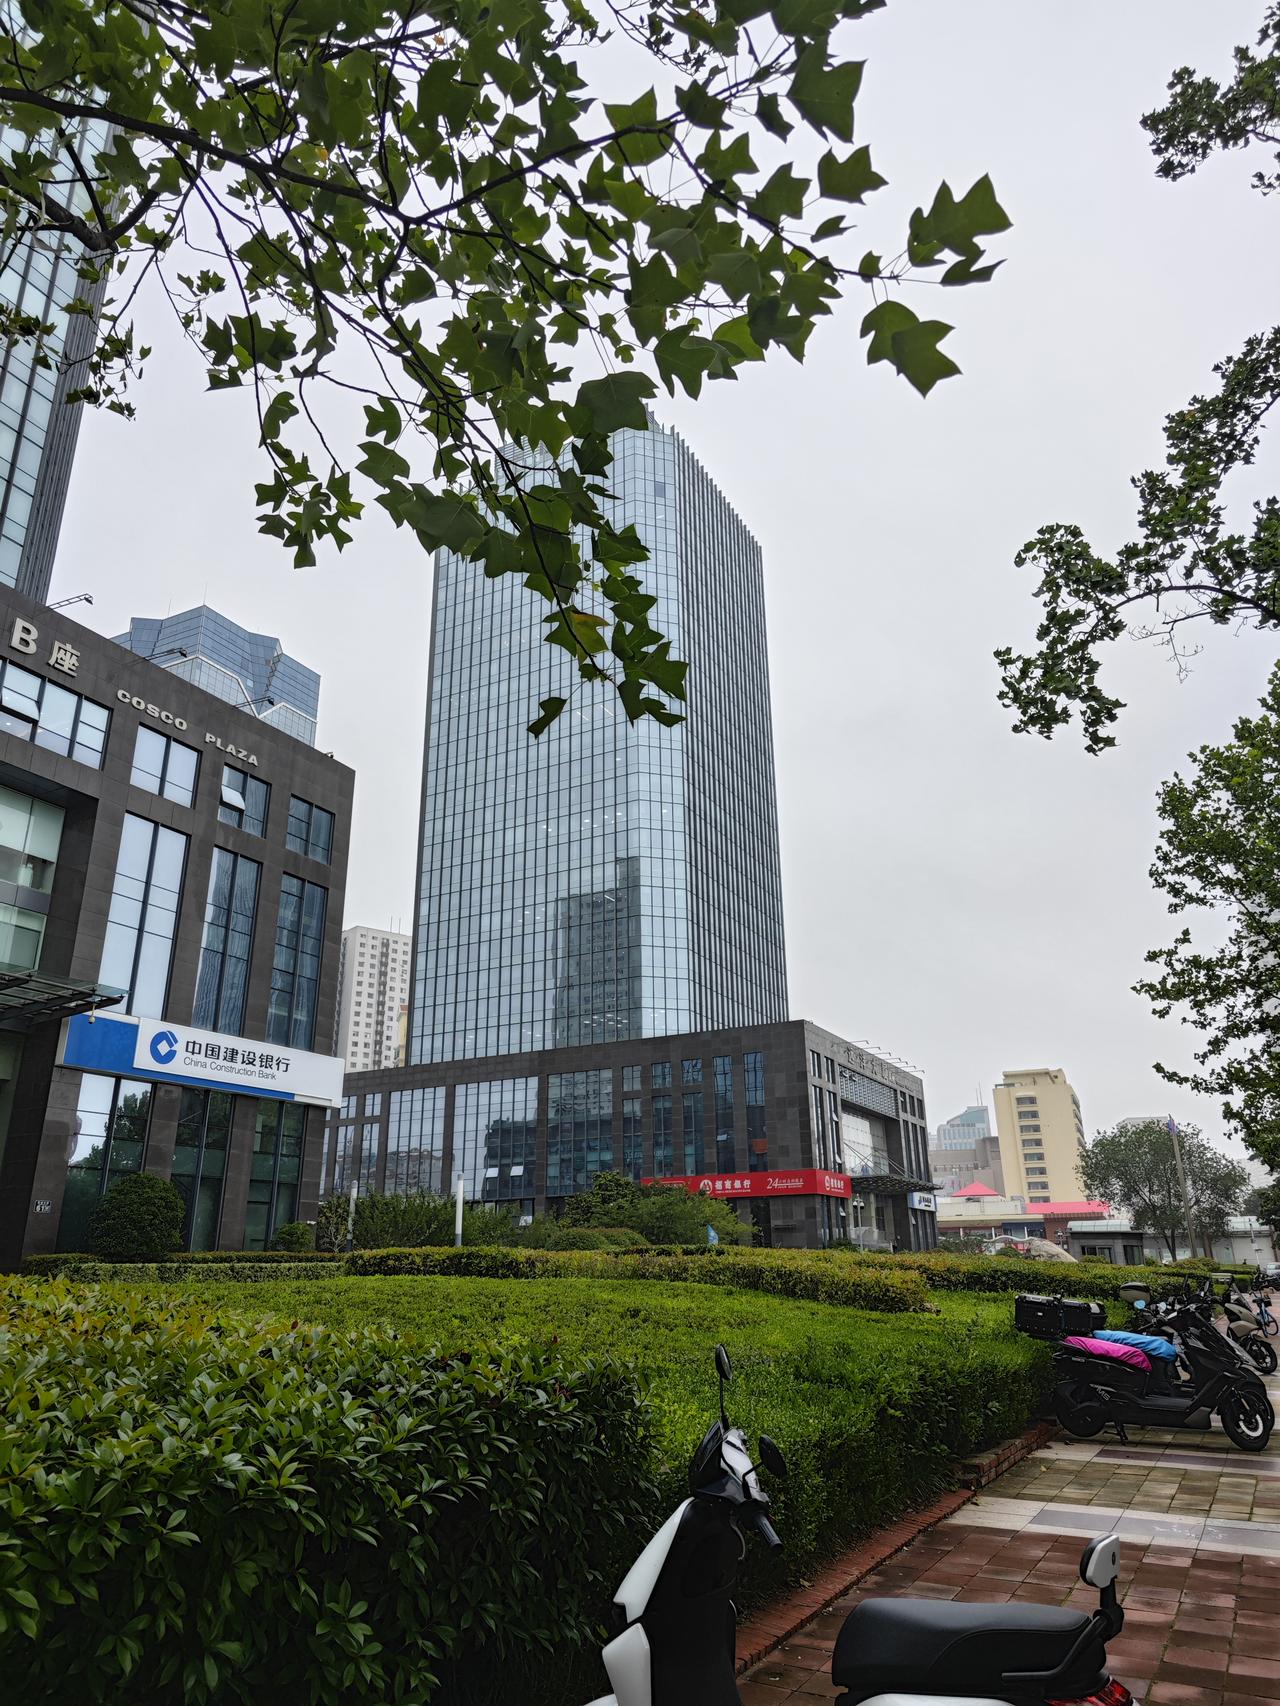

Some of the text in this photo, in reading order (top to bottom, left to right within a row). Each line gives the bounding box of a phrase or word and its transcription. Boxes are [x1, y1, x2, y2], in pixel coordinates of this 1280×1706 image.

[116, 688, 259, 767] COSCO PLAZA
[183, 1056, 277, 1080] China Construction Bank
[185, 1040, 291, 1073] 中国建设银行
